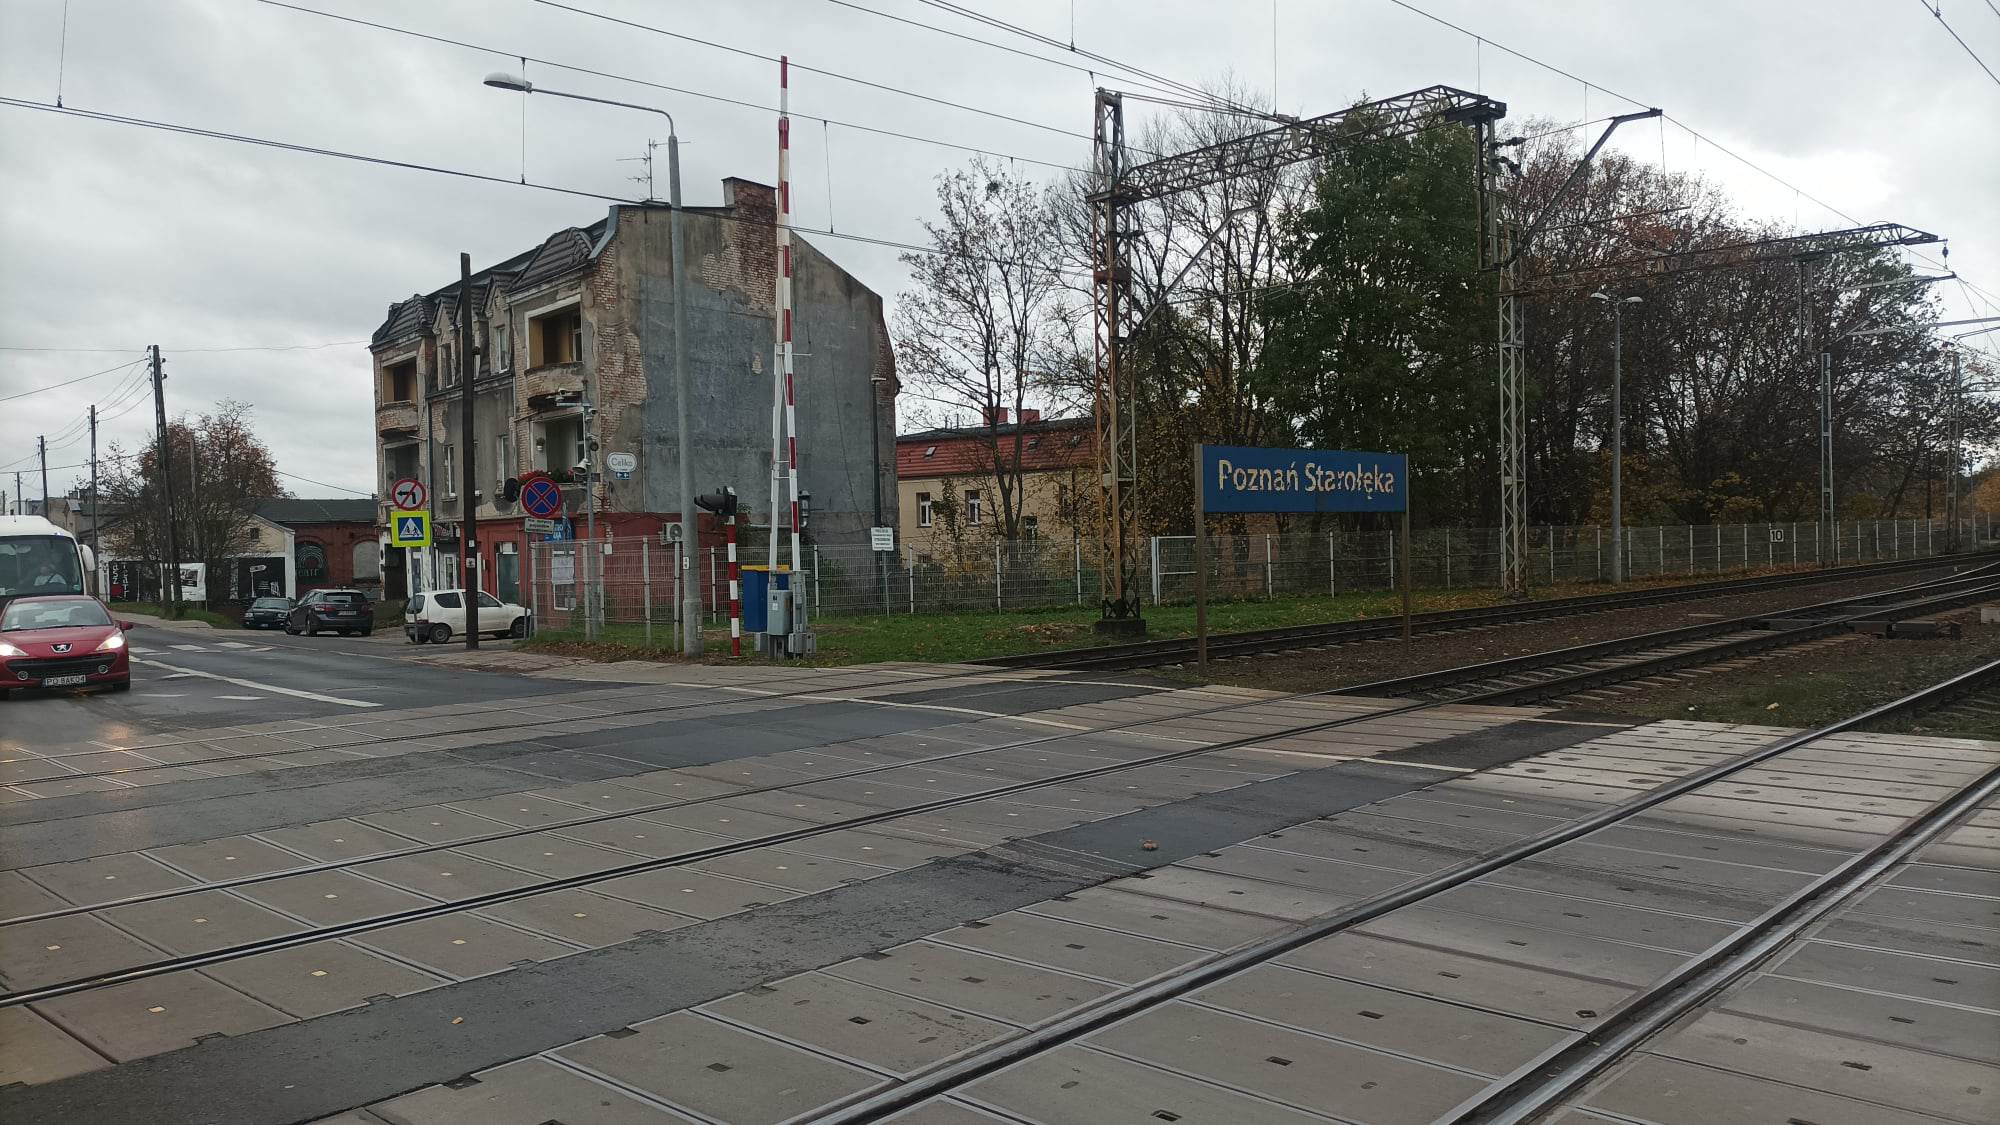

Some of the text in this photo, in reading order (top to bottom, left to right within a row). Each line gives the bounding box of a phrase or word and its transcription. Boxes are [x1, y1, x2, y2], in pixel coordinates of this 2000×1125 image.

[1218, 459, 1394, 500] Poznań Starołęka
[1771, 530, 1783, 541] 10
